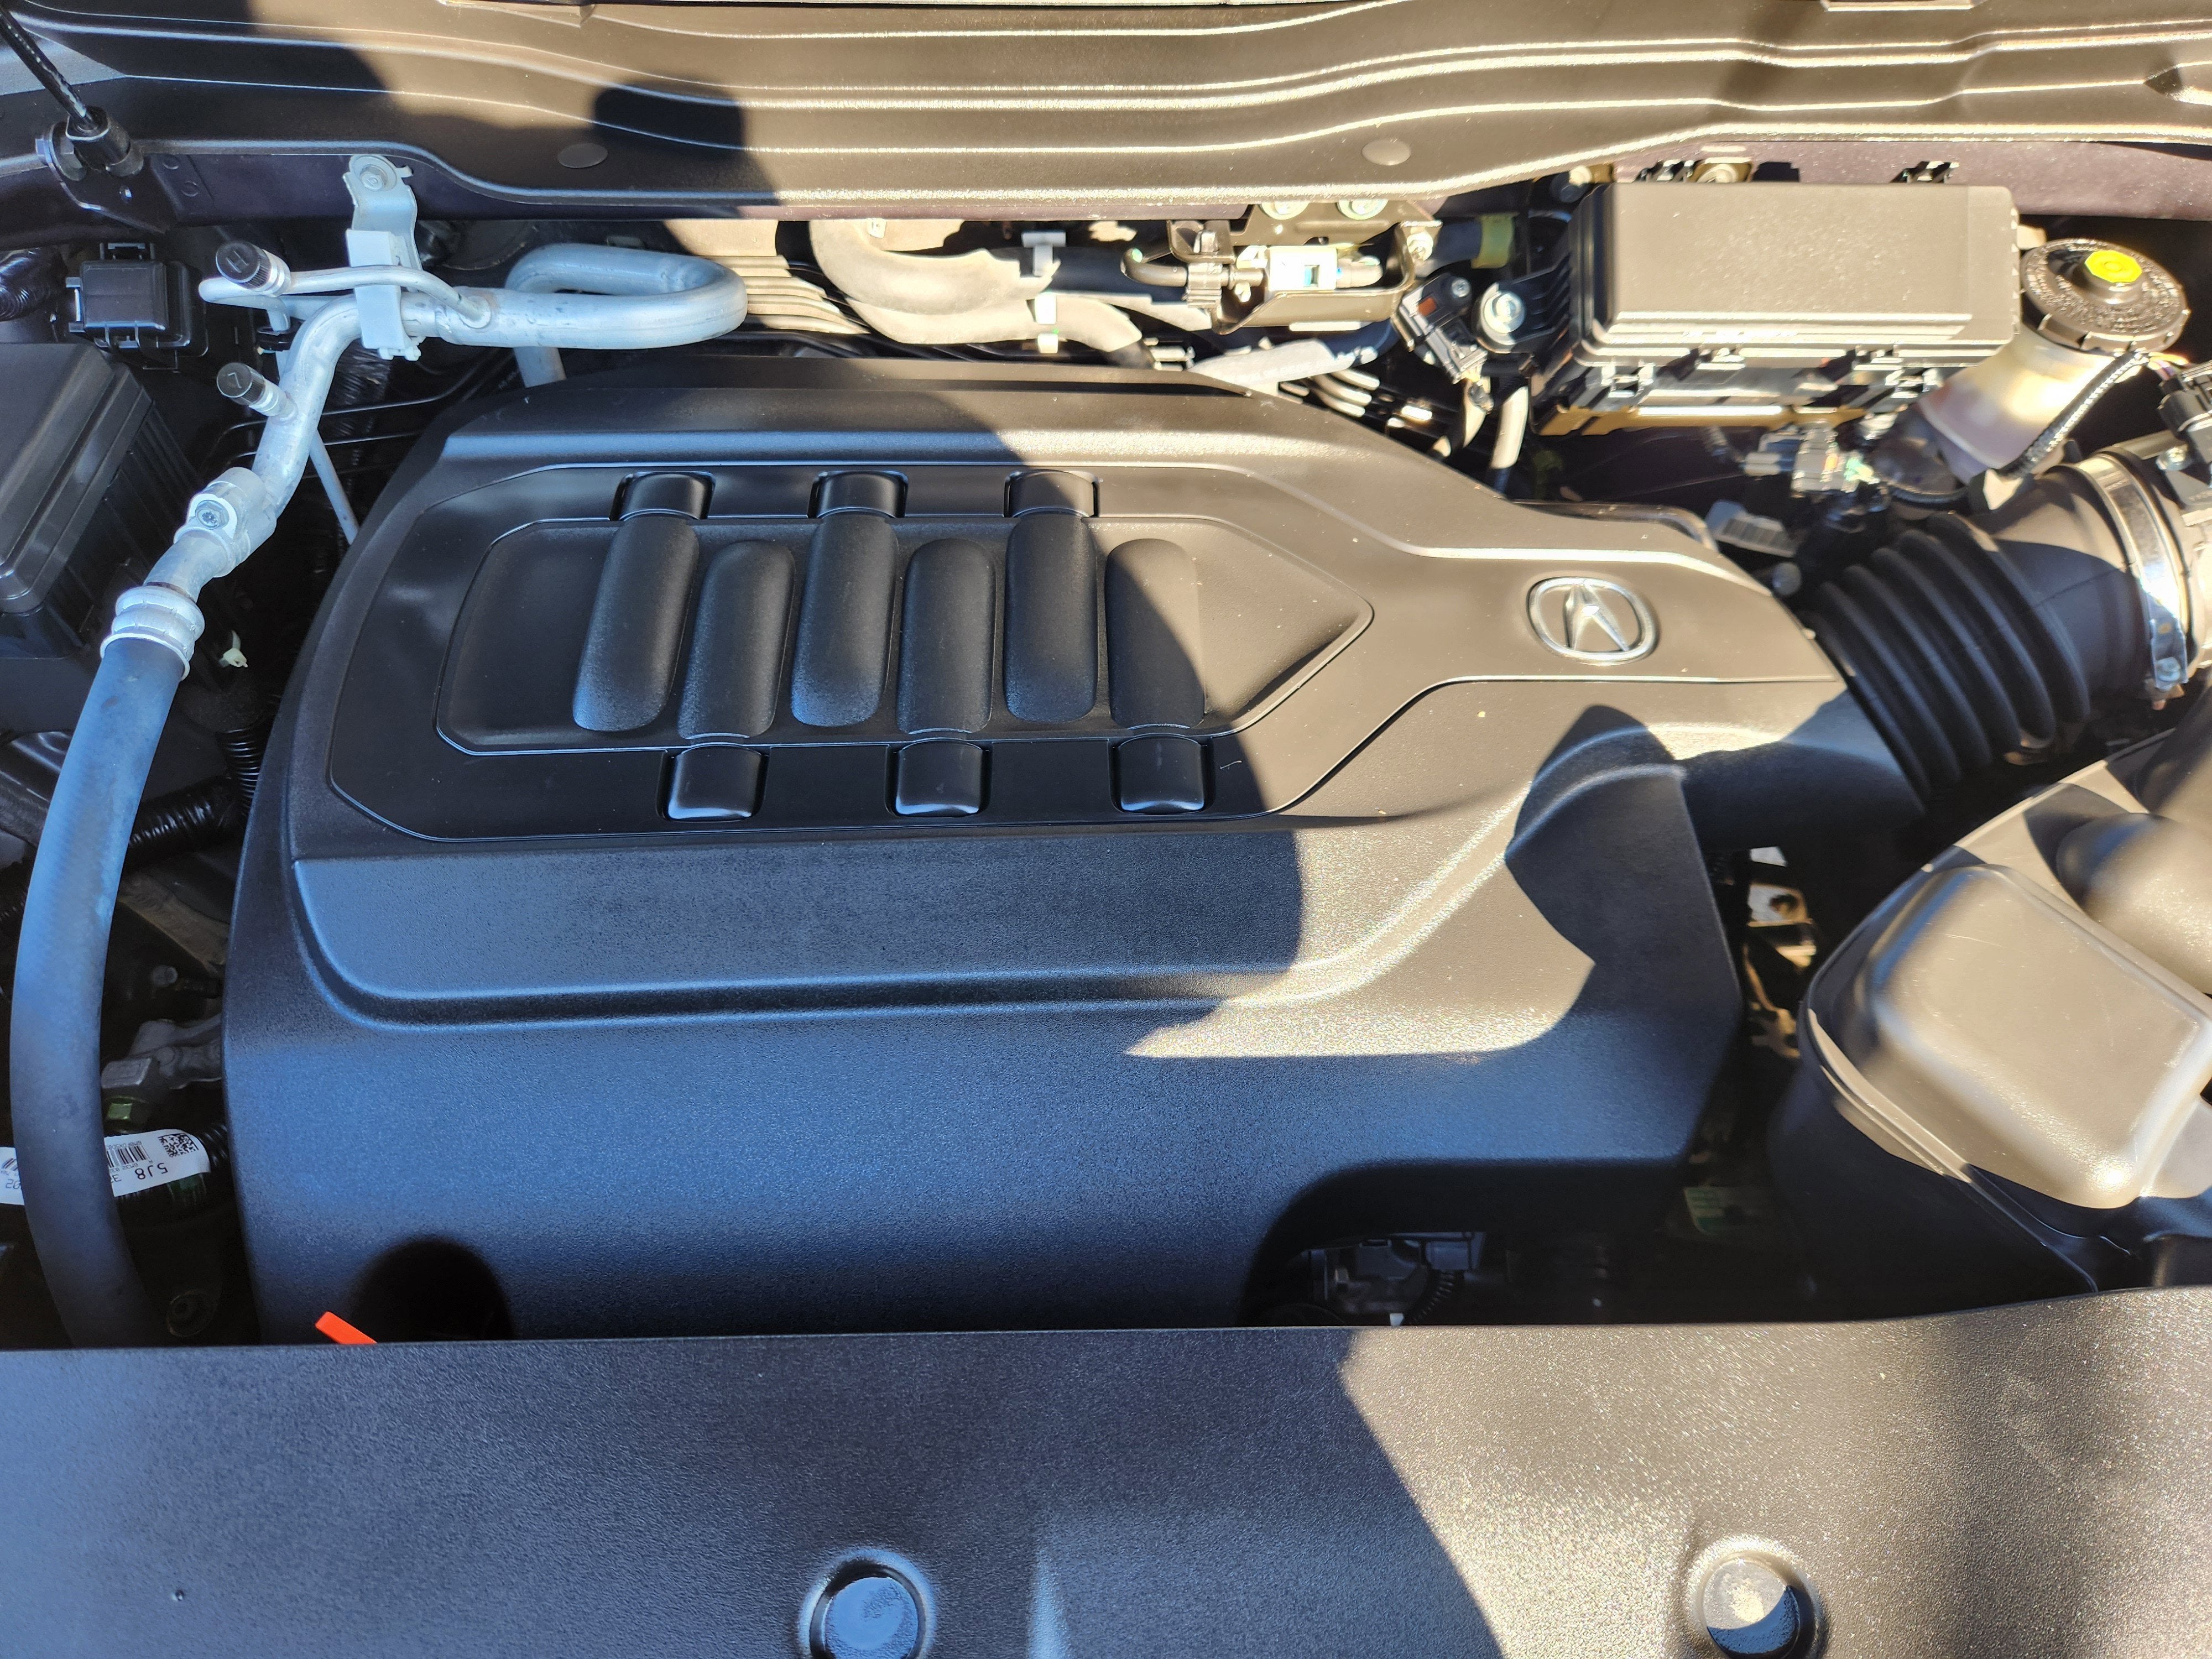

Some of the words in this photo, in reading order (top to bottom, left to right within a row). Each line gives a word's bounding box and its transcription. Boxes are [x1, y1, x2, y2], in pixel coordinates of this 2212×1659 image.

[226, 250, 249, 274] H
[111, 1174, 122, 1183] 3
[134, 1162, 168, 1180] 5J8
